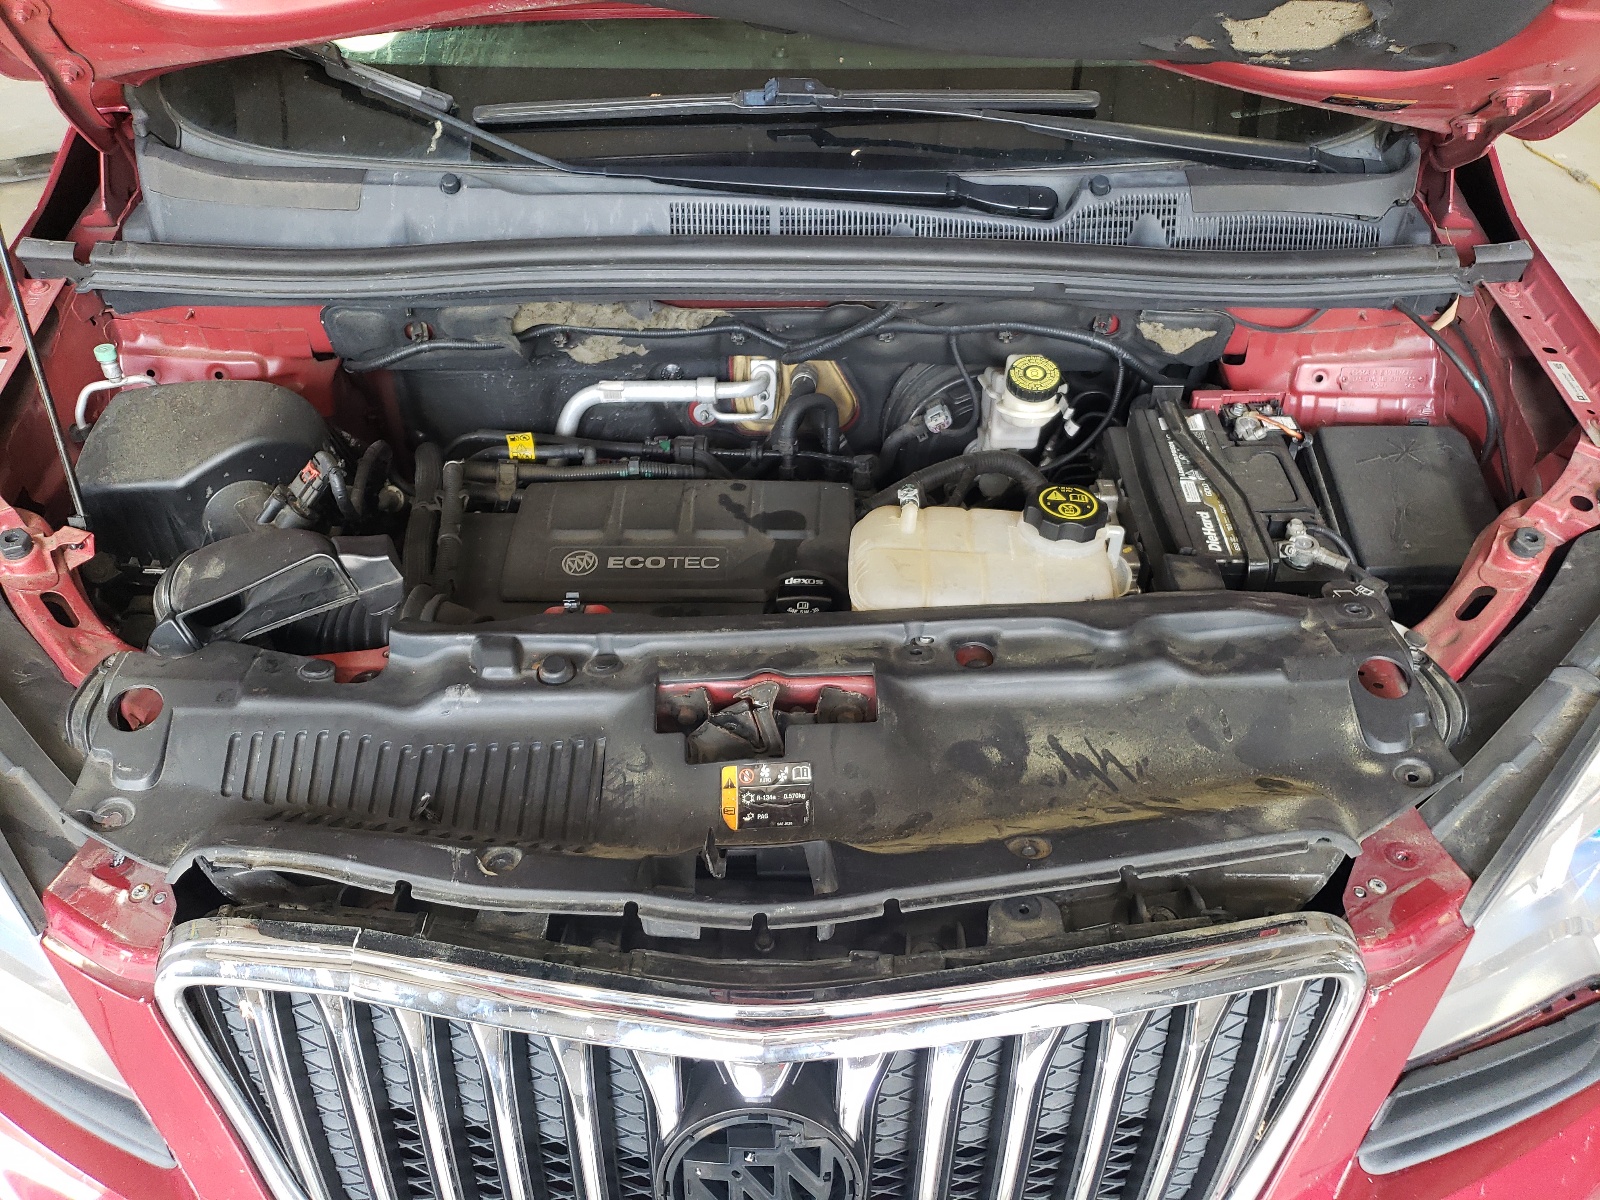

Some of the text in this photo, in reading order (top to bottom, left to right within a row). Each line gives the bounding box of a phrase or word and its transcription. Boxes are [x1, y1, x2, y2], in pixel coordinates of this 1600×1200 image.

[1196, 511, 1222, 551] DieHard
[607, 556, 720, 569] ECOTEC
[784, 577, 824, 585] dexos
